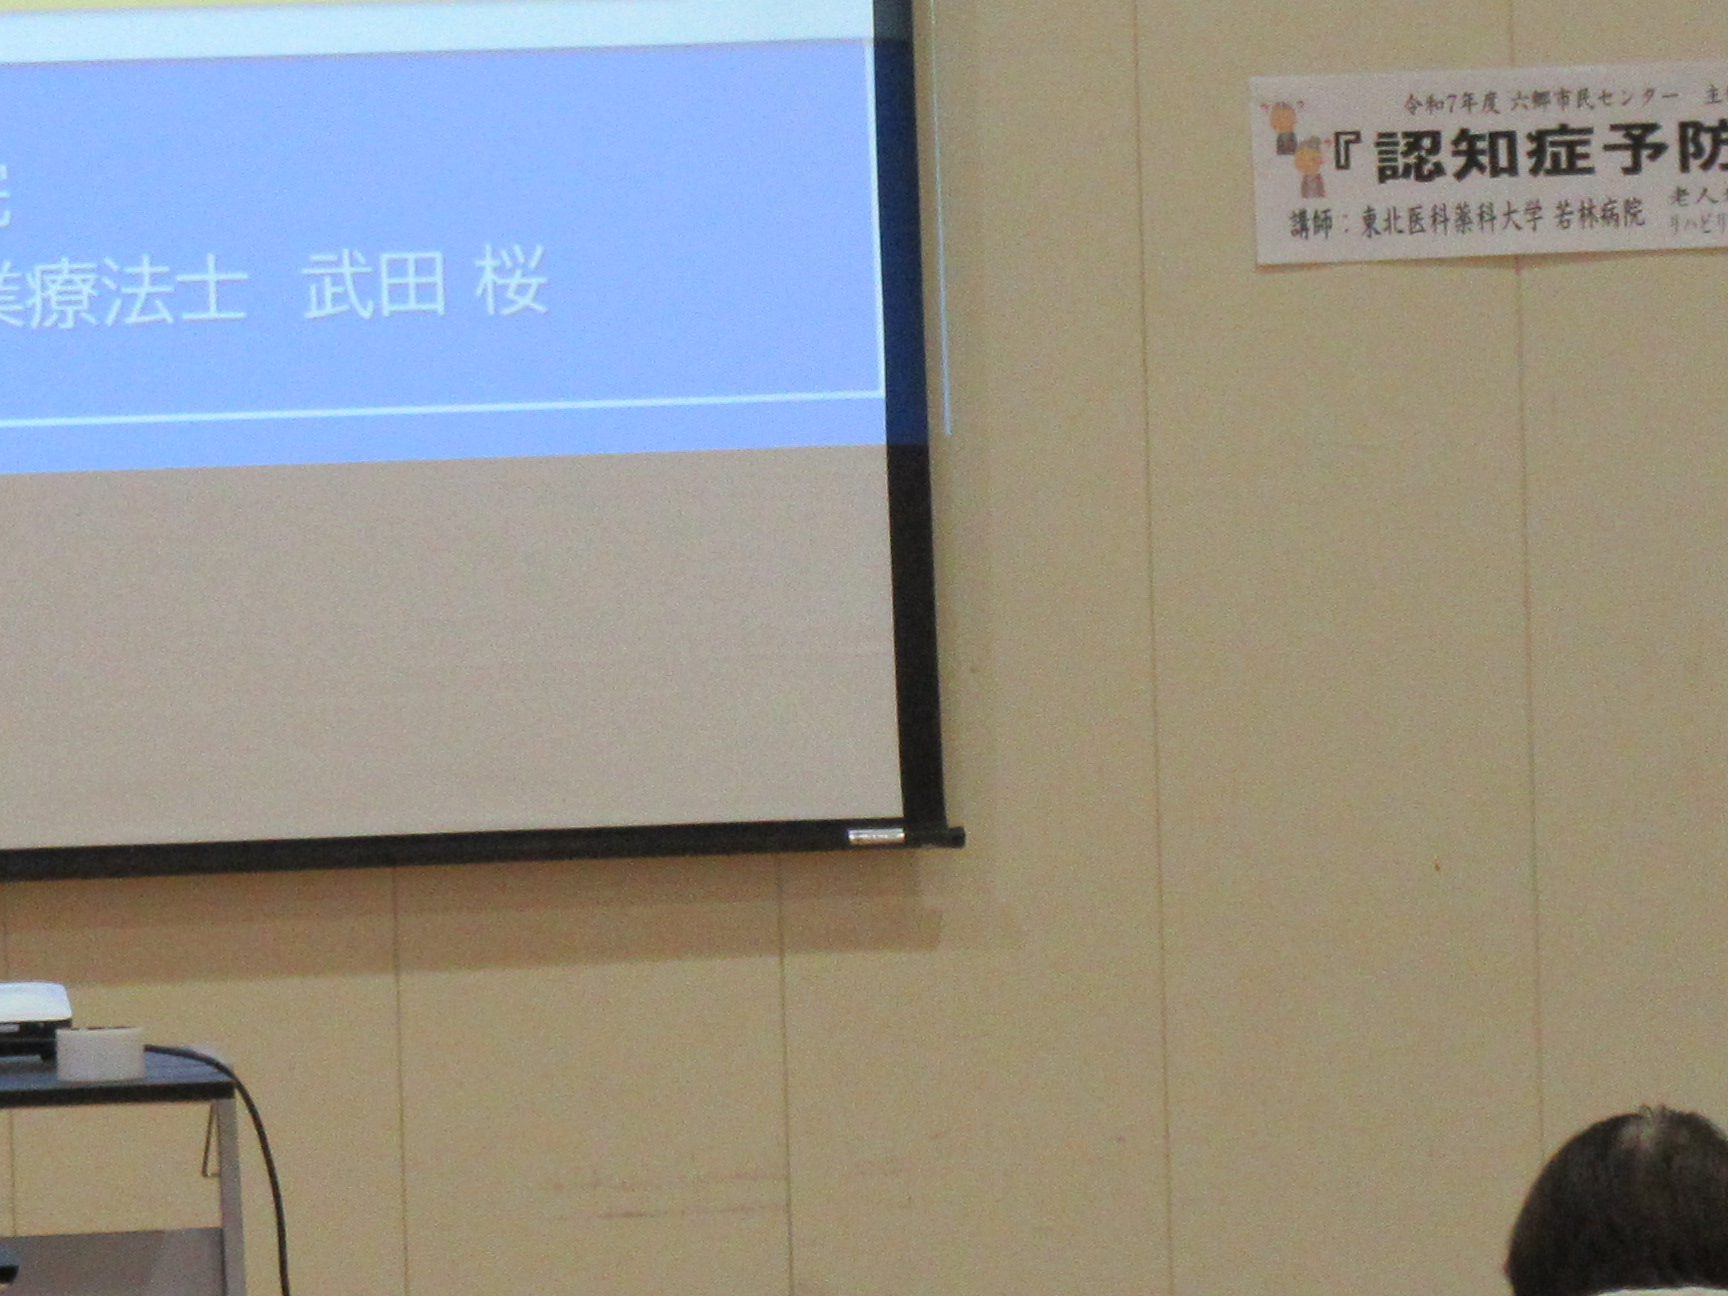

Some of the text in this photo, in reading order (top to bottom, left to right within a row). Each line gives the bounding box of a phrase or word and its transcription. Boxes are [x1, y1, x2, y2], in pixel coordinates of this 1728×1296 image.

[1404, 90, 1501, 116] 令和7年度
[1510, 86, 1680, 112] 六郷市民センター
[1555, 197, 1647, 232] 若林病院
[300, 246, 447, 323] 武田
[473, 242, 551, 318] 桜
